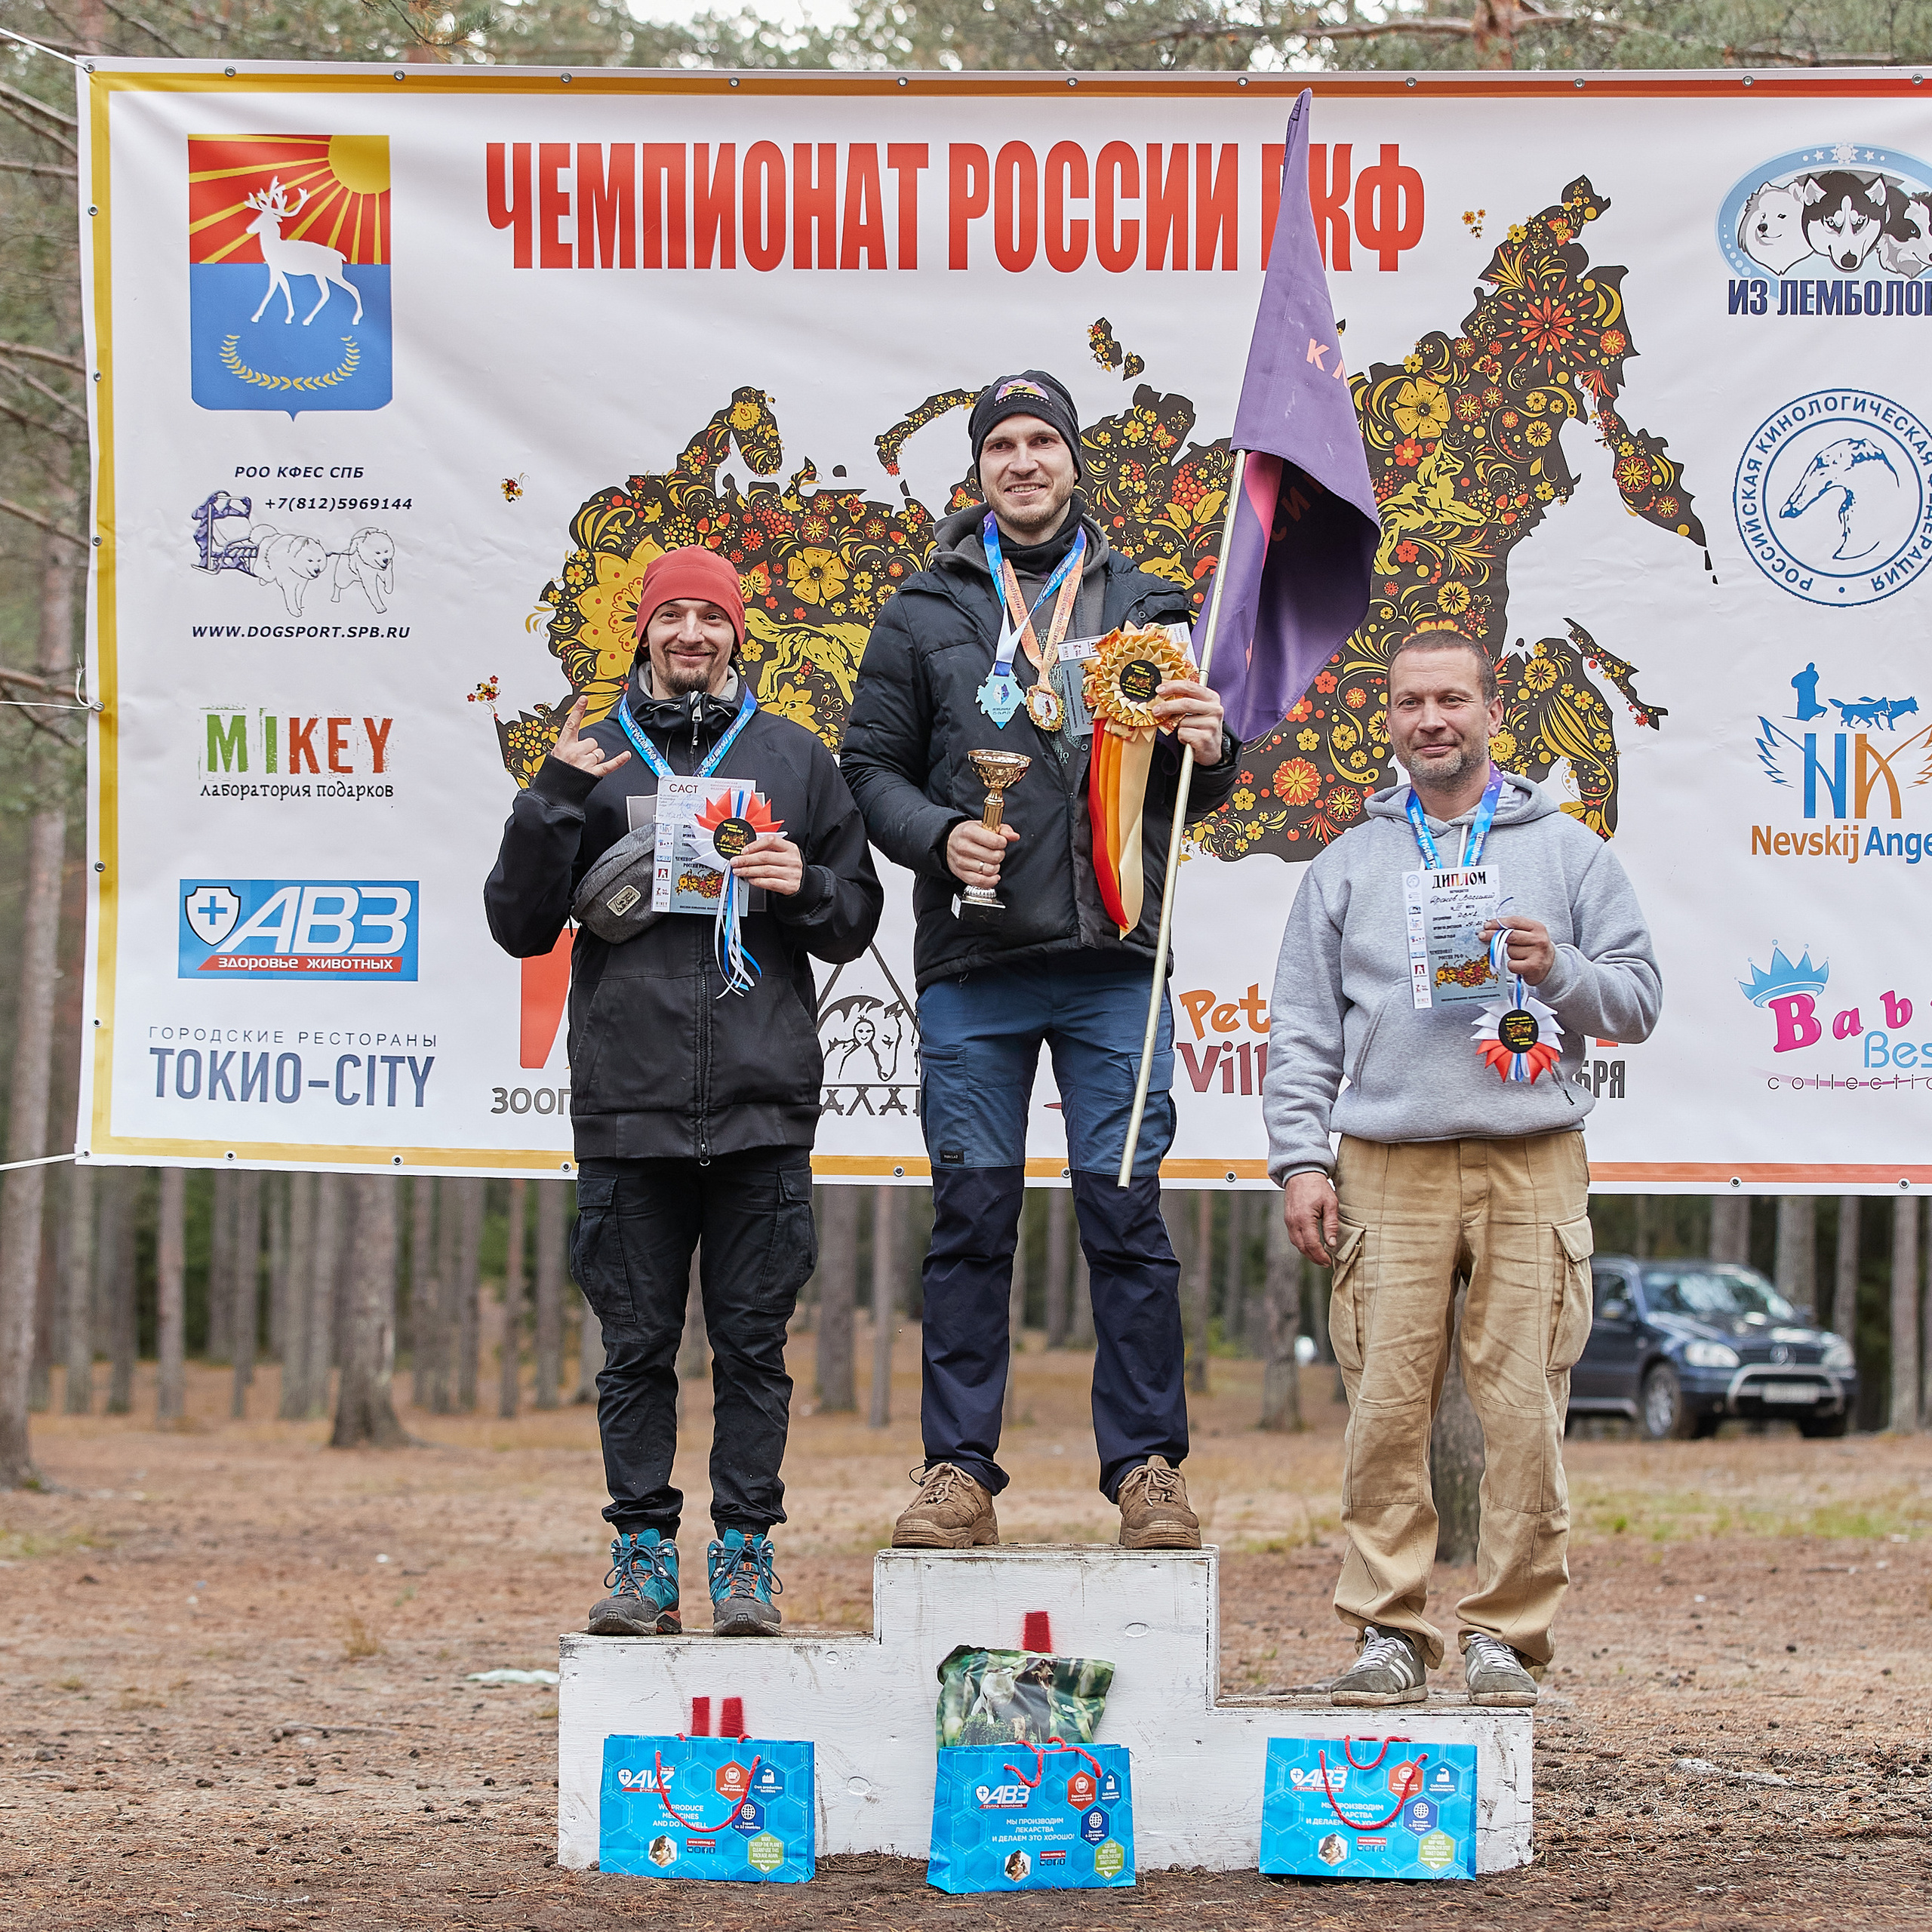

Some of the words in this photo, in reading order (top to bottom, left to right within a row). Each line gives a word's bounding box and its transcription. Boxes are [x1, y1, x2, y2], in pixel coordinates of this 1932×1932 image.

[486, 140, 928, 272] ЧЕМПИОНАТ
[949, 140, 1238, 272] РОССИИ
[1728, 279, 1767, 315] ИЗ
[1755, 395, 1932, 466] КИНОЛОГИЧЕСКАЯ
[235, 466, 270, 478] РОО
[277, 466, 324, 478] КФЕС
[329, 467, 364, 478] СПБ
[266, 497, 413, 512] +7(812)5969144
[1742, 457, 1814, 592] РОССИЙСКАЯ
[192, 626, 411, 639] WWW.DOGSPORT.SPB.RU
[206, 713, 394, 775] MIKEY
[200, 783, 311, 801] лаборатория
[317, 780, 394, 801] подарков
[1752, 825, 1860, 863] Nevskij
[1432, 871, 1487, 889] ДИПЛОМ
[216, 886, 412, 954] АВЗ
[218, 956, 298, 971] здоровье
[306, 957, 393, 970] животных
[1179, 983, 1271, 1041] Pet
[149, 1026, 284, 1044] ГОРОДСКИЕ
[299, 1032, 437, 1048] РЕСТОРАНЫ
[149, 1048, 435, 1107] ТОКИО-CITY
[1297, 1768, 1348, 1788] АВЗ
[983, 1785, 1031, 1804] АВЗ
[1019, 1817, 1063, 1826] ПРОИЗВОДИМ
